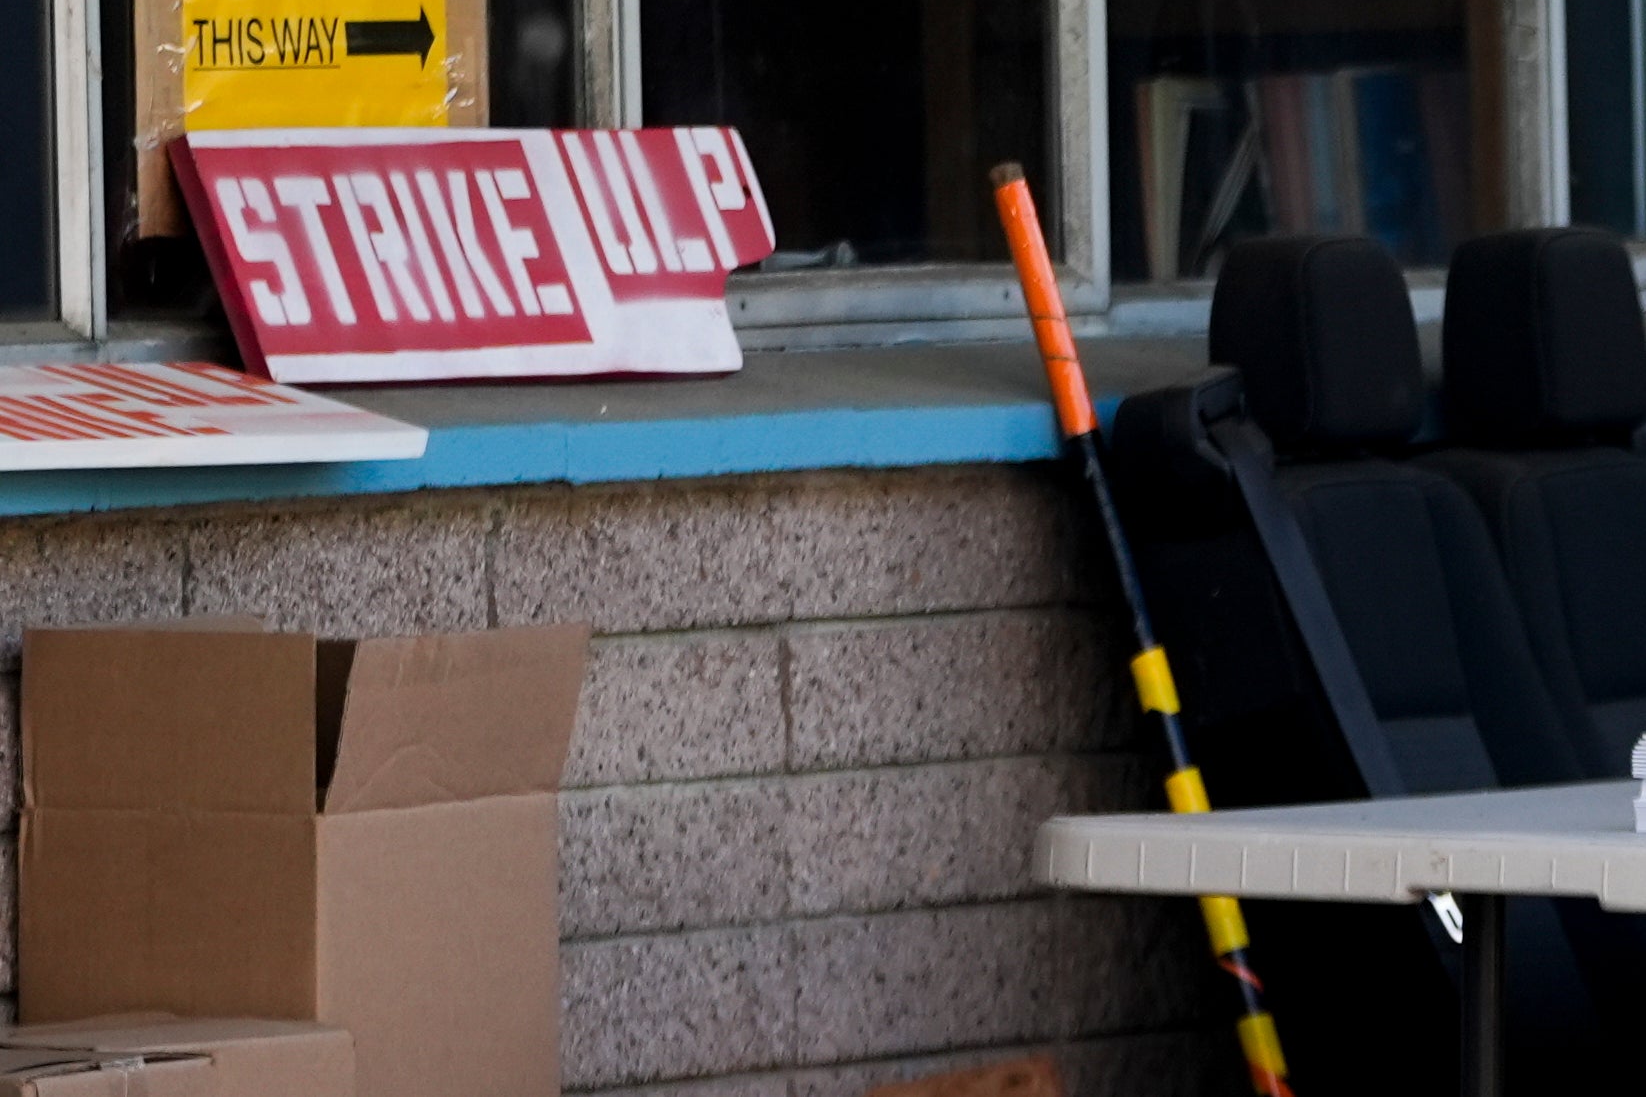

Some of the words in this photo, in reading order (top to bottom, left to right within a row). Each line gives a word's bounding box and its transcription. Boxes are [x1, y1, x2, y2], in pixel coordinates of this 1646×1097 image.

[193, 17, 266, 66] THIS
[270, 16, 339, 66] WAY
[214, 168, 574, 327] STRIKE
[562, 126, 746, 275] ULP
